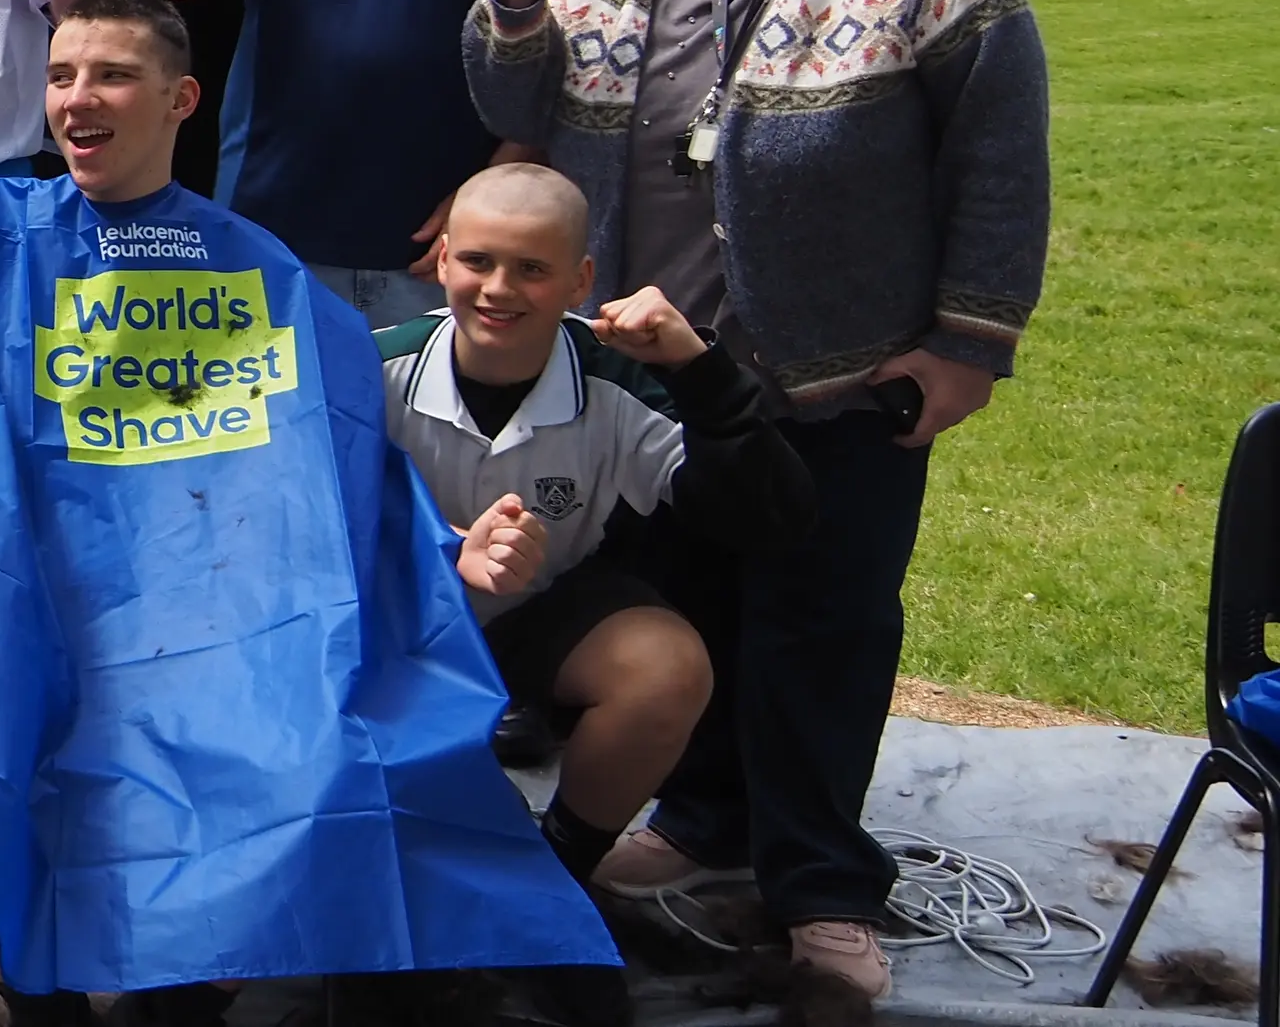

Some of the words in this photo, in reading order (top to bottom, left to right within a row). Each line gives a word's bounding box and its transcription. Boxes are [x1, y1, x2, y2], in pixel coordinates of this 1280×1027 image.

[96, 222, 201, 244] Leukaemia
[99, 240, 209, 261] Foundation
[72, 285, 254, 334] World's
[45, 344, 282, 391] Greatest
[78, 406, 251, 449] Shave
